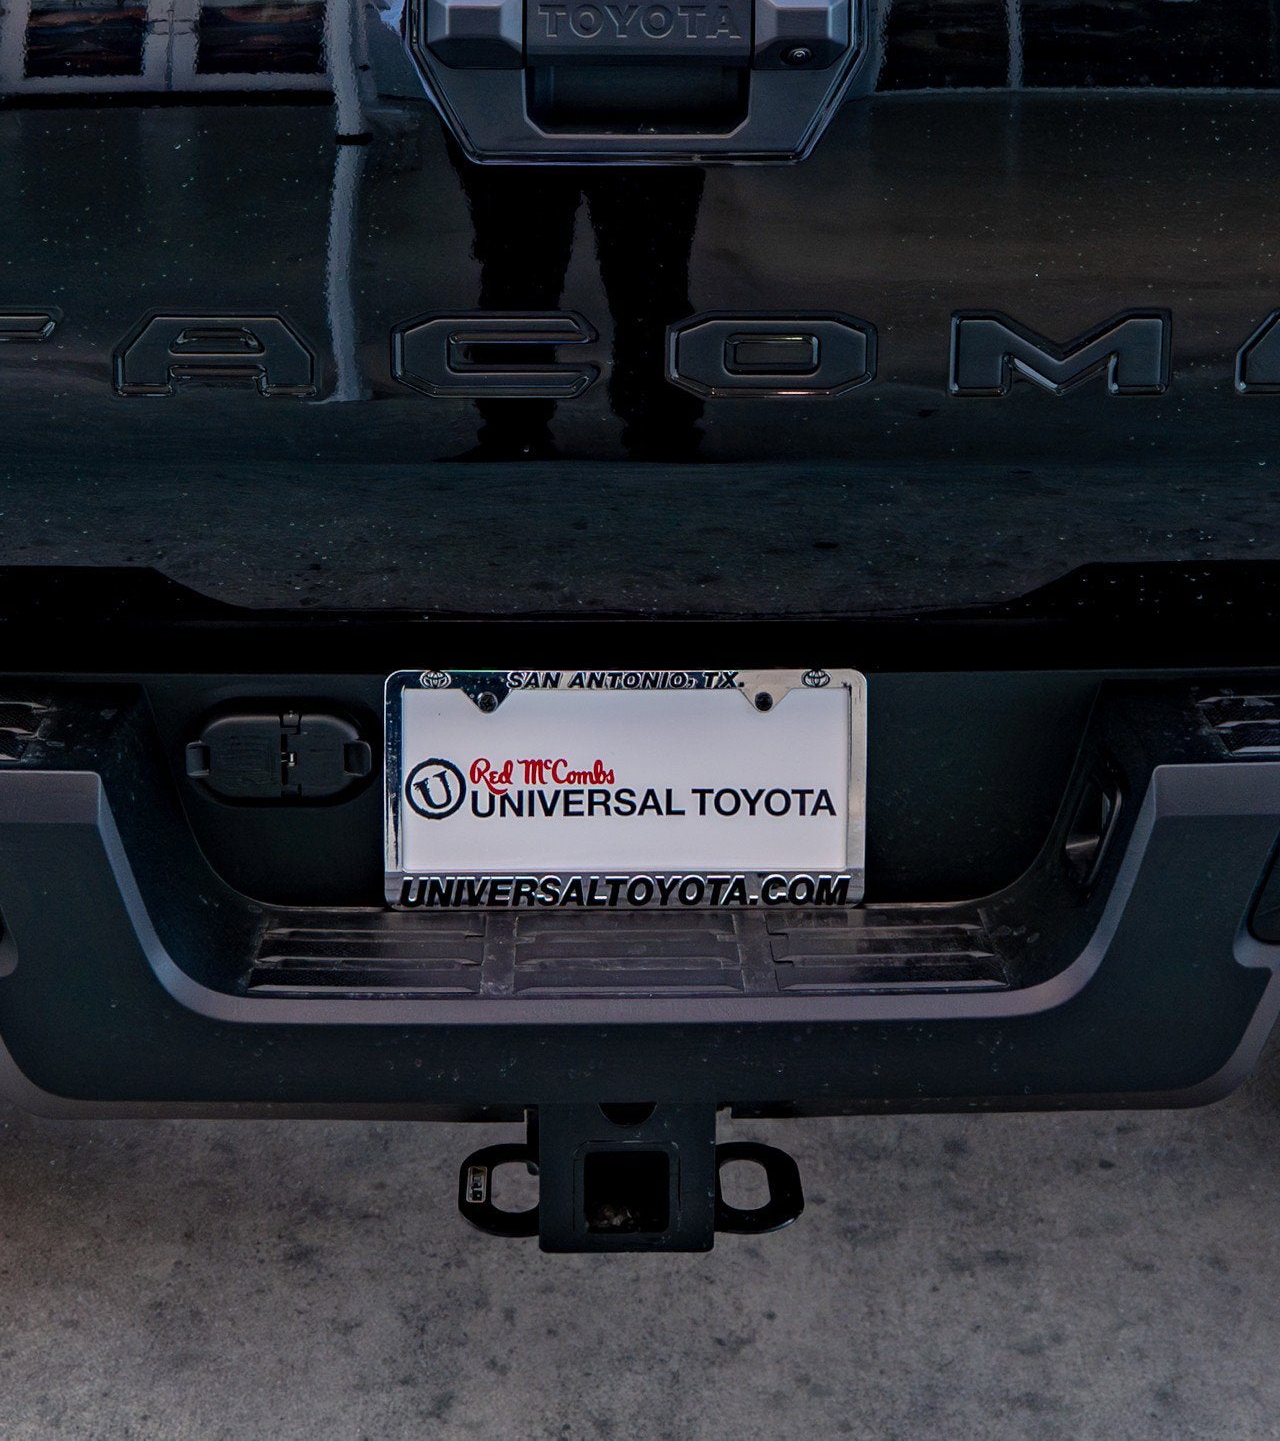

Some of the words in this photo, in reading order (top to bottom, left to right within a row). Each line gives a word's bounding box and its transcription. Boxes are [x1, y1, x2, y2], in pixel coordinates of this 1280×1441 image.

[537, 3, 741, 39] TOYOTA
[506, 670, 564, 689] SAN
[568, 670, 696, 690] ANTONIO,
[702, 670, 744, 689] TX.
[470, 758, 514, 796] Red
[516, 758, 615, 785] McCombs
[471, 788, 684, 818] UNIVERSAL
[692, 788, 836, 817] TOYOTA
[400, 875, 850, 908] UNIVERSALTOYOTA.COM
